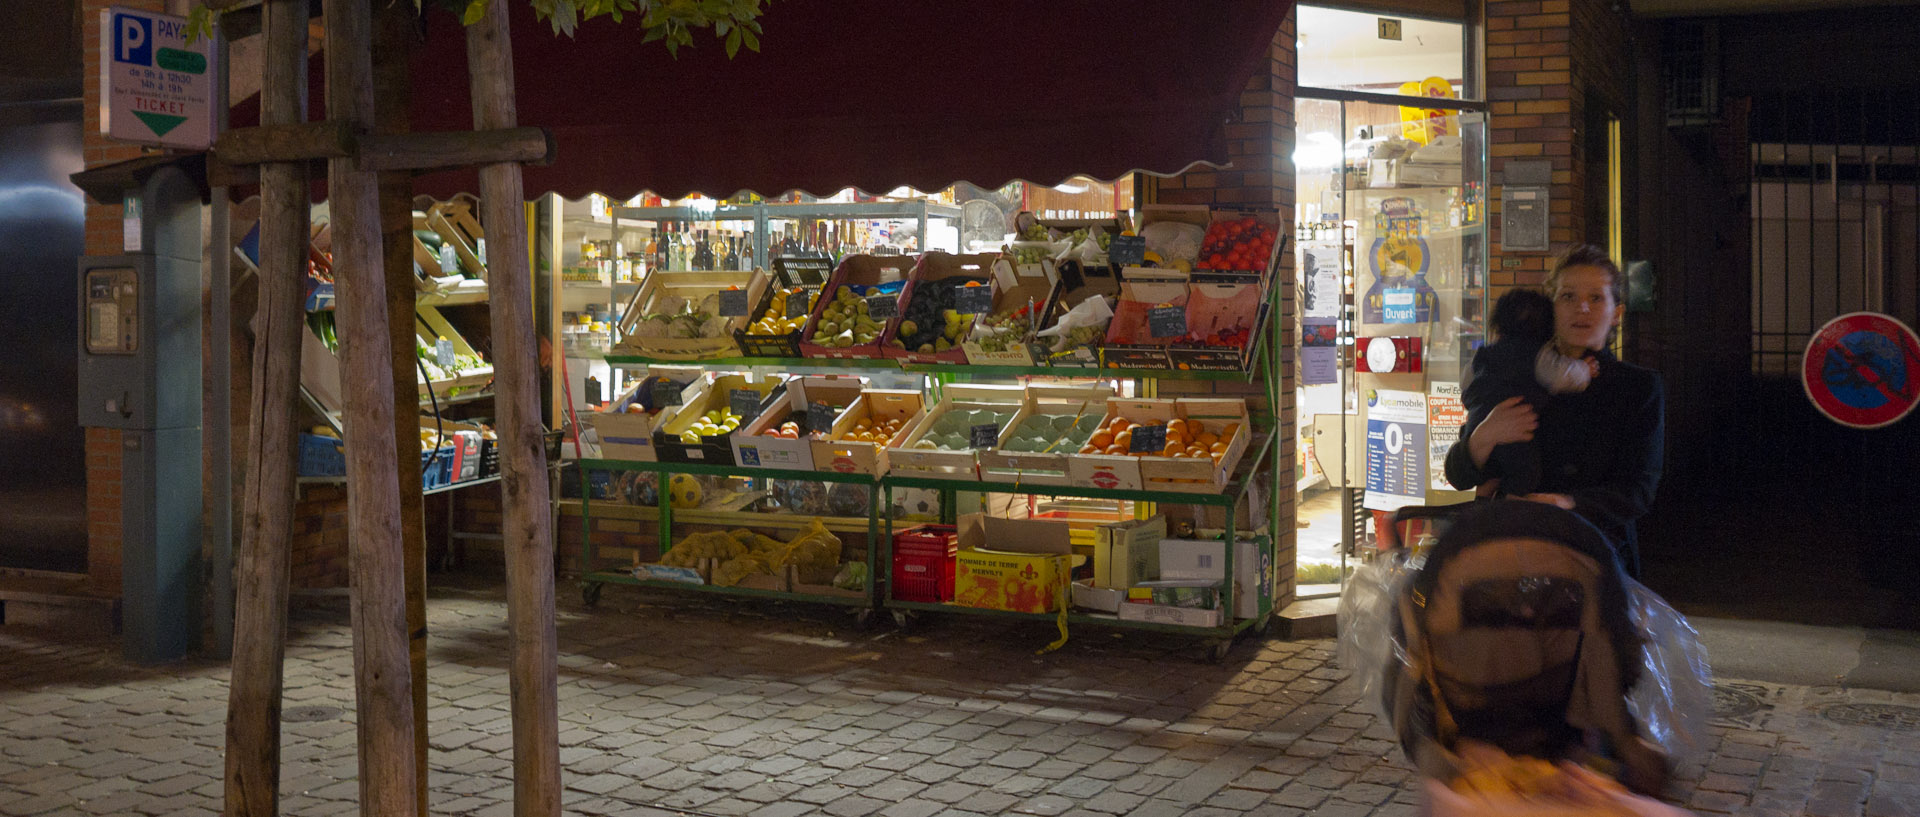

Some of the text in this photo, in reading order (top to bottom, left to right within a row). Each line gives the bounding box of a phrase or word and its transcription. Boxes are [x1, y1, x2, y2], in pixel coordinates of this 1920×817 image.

[121, 16, 145, 61] P
[129, 68, 192, 84] de 9h à 12h30
[141, 79, 183, 93] 14h à 19h
[135, 97, 185, 115] TICKET
[1385, 307, 1413, 319] Ouvert
[1120, 361, 1166, 369] Mademoiselle
[1191, 362, 1238, 370] Mademoiselle
[1436, 386, 1461, 394] Nord Ec
[1380, 396, 1424, 408] Lycamobile
[1385, 422, 1403, 455] 0
[959, 558, 986, 566] POMMES
